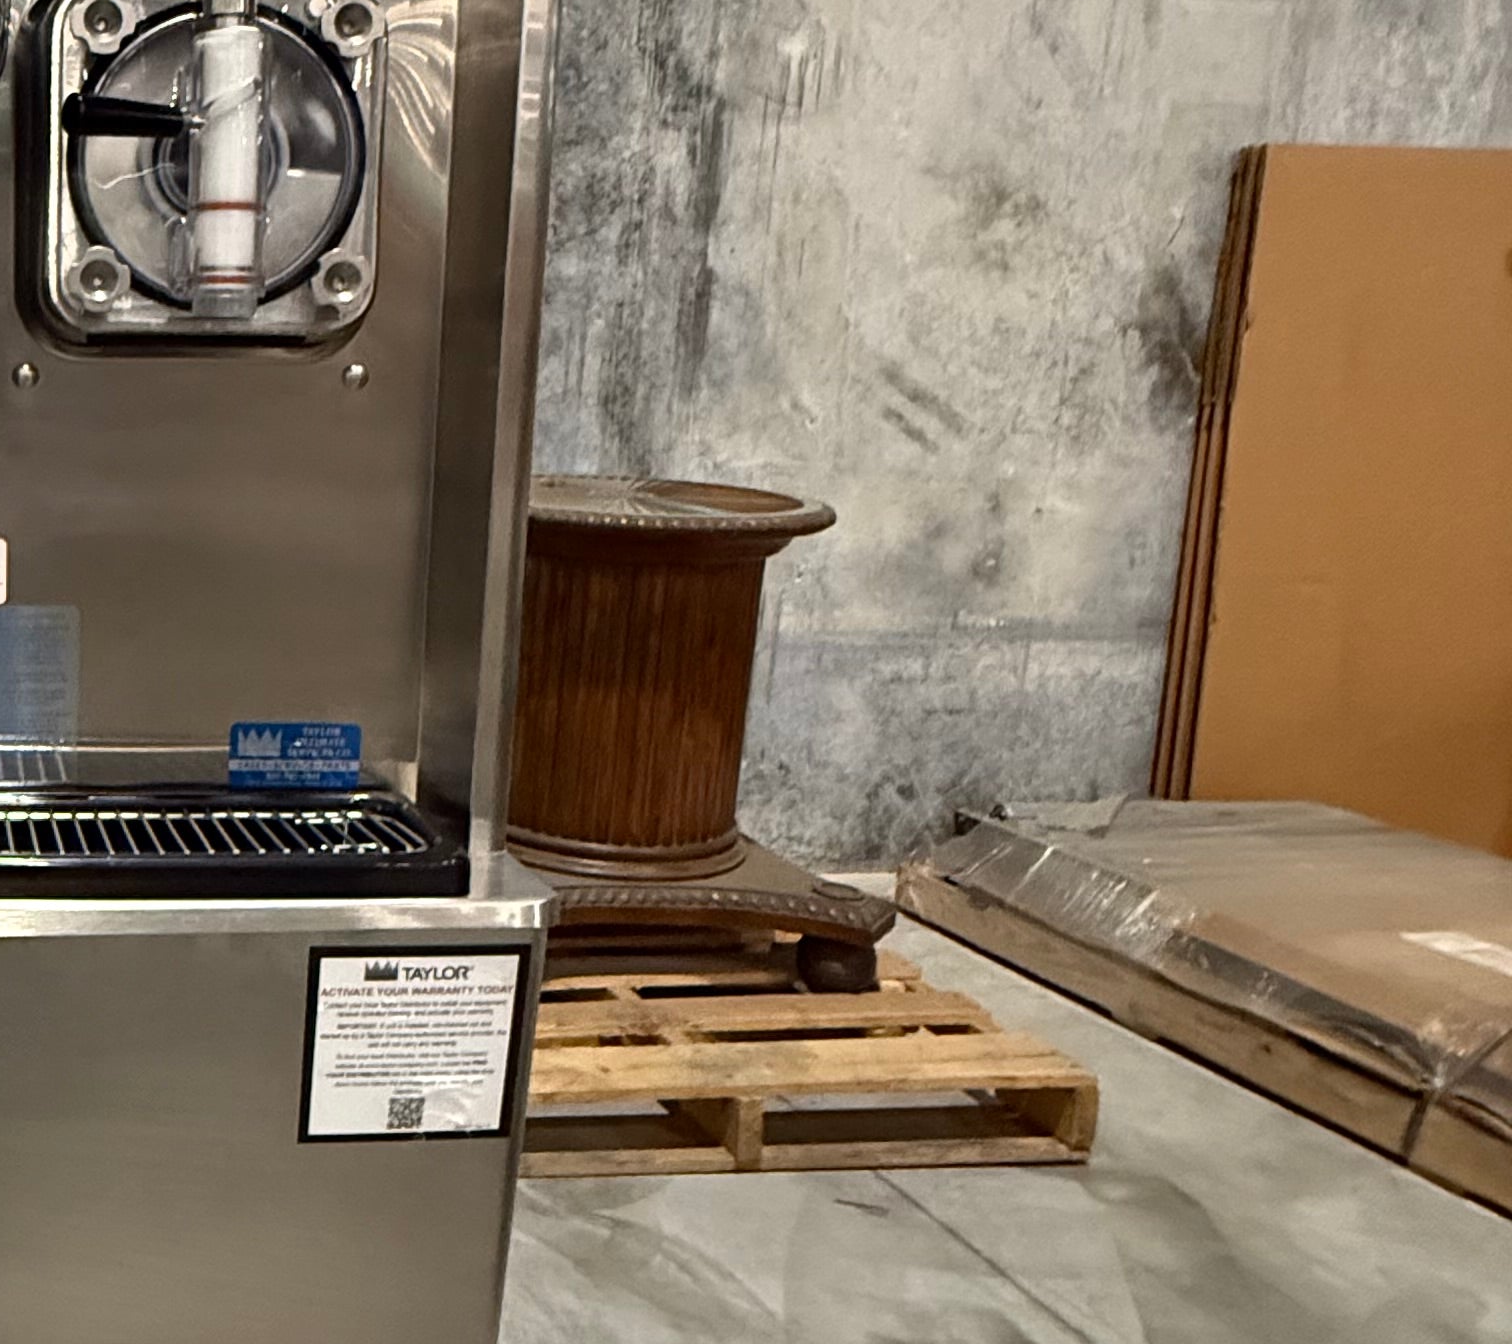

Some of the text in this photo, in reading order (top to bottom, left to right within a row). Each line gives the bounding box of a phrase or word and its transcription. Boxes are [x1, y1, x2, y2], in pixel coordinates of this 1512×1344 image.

[402, 965, 469, 981] TAYLOR
[321, 985, 514, 997] ACTIVATE YOUR WARRANTY TODAY
